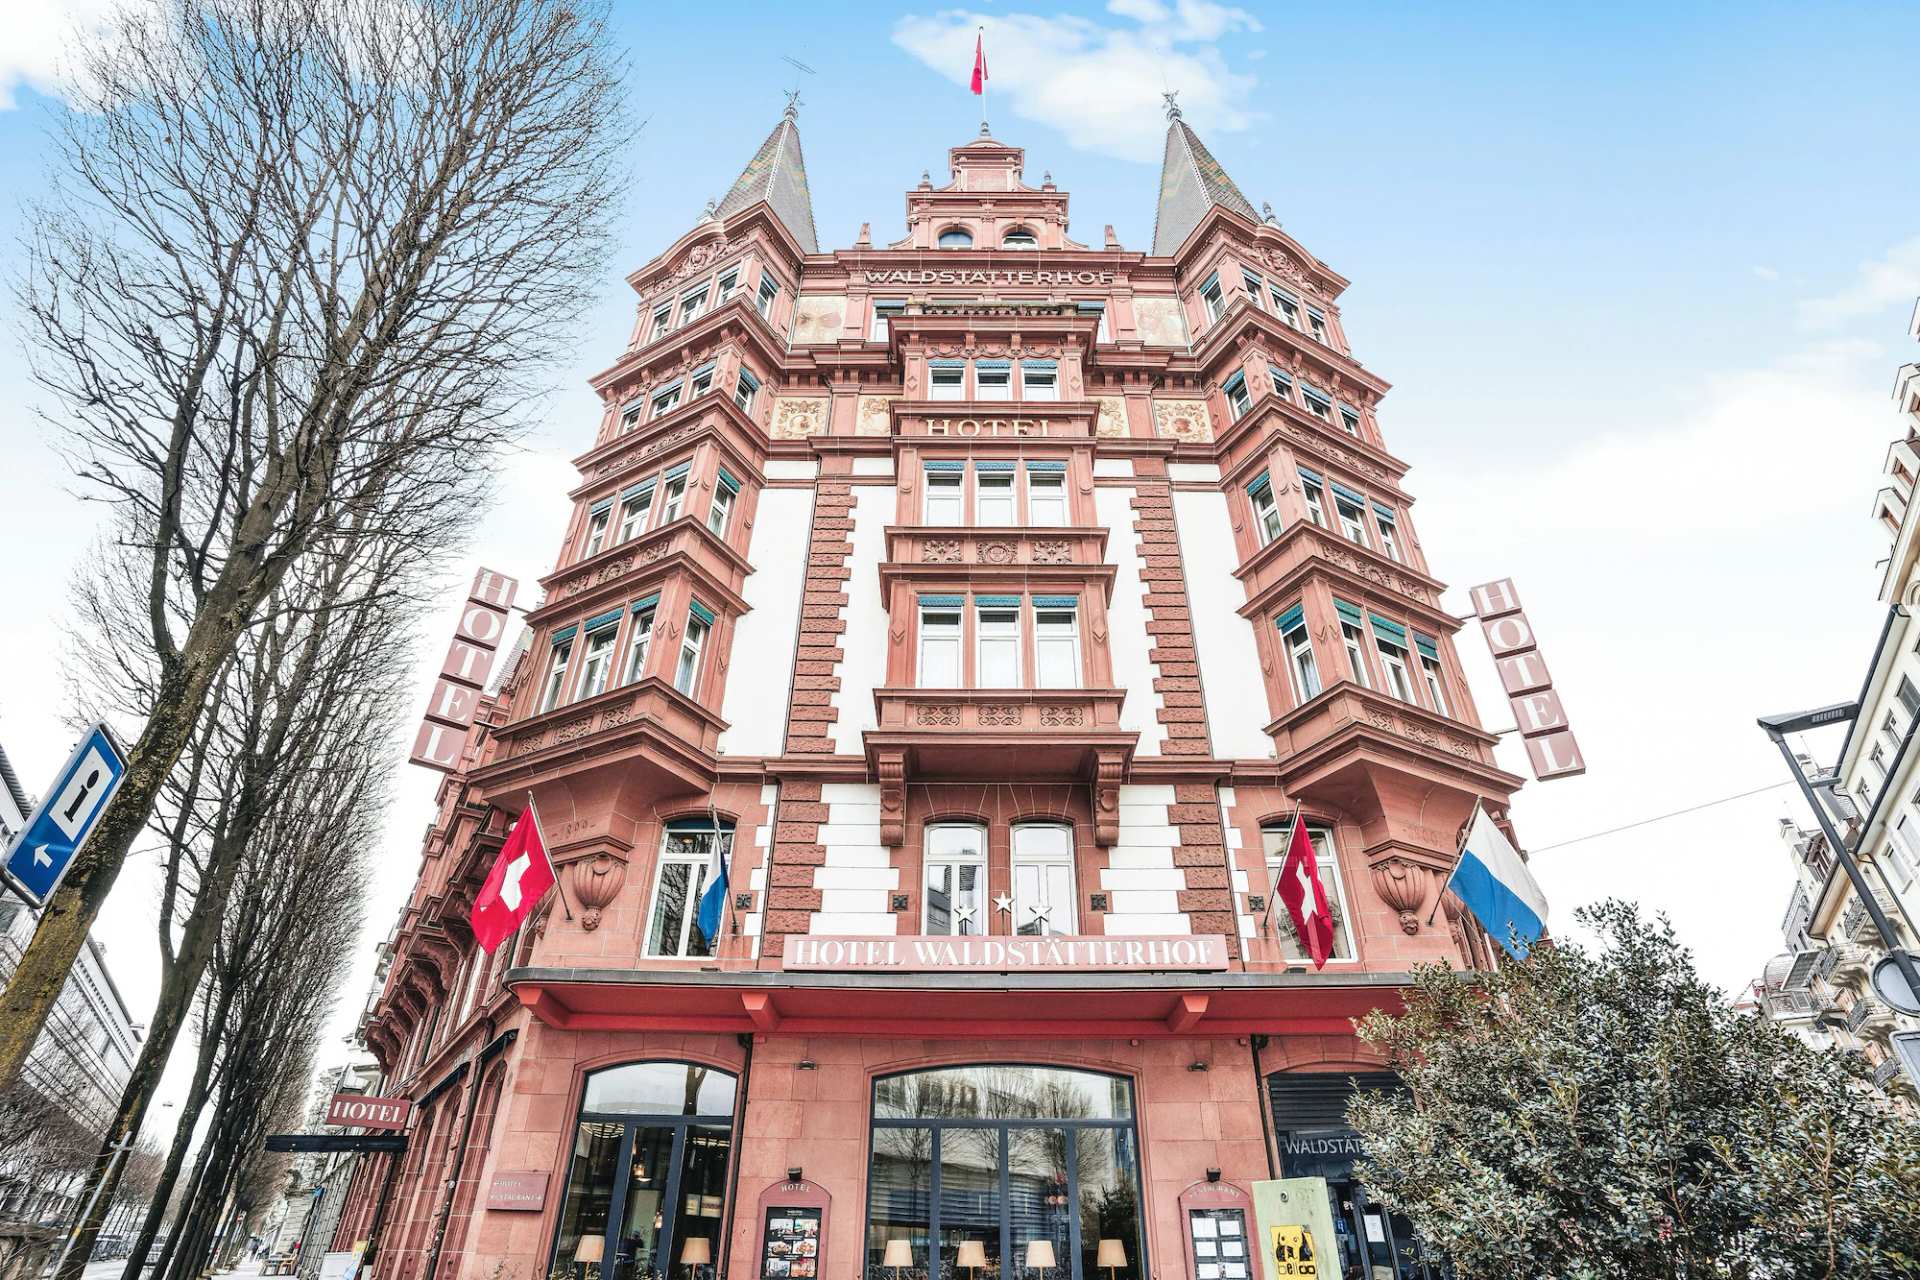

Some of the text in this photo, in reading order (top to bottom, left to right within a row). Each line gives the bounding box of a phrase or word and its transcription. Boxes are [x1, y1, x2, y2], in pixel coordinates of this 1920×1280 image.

[926, 419, 1064, 437] HOTEL
[421, 570, 514, 766] HOTEL
[1477, 580, 1577, 773] HOTEL
[794, 938, 1214, 966] HOTEL WALDSTÄTTERHOF
[332, 1101, 404, 1123] HOTEL
[781, 1183, 811, 1193] HOTEL
